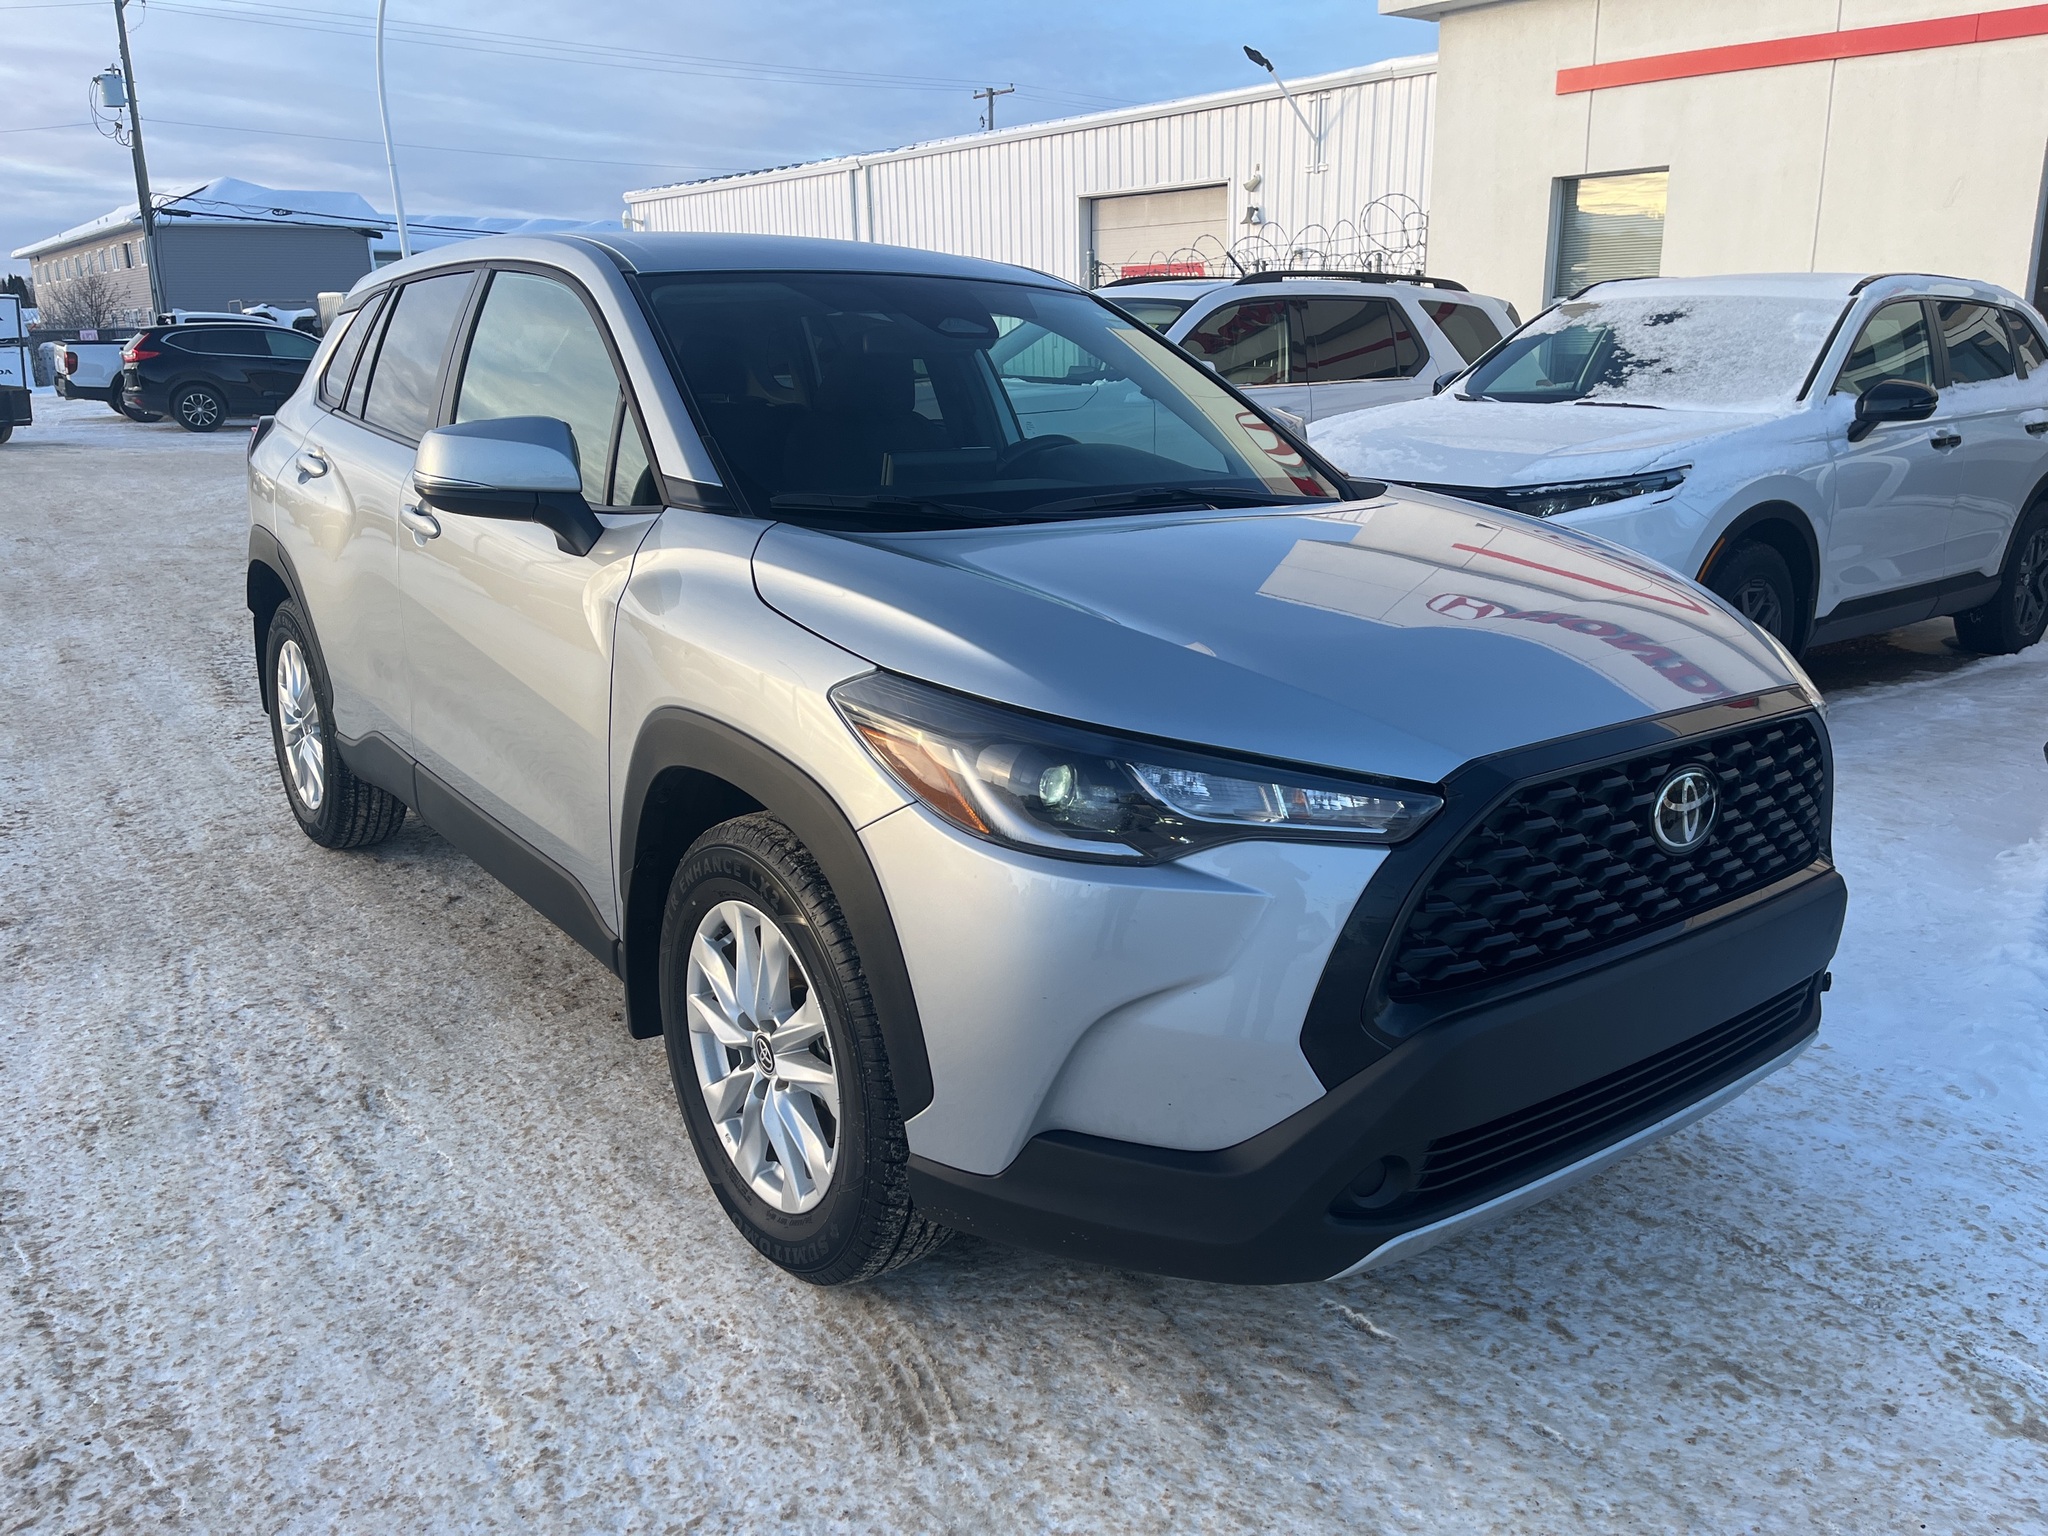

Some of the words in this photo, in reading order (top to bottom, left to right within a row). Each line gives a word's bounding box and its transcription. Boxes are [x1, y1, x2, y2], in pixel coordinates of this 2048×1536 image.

[679, 856, 742, 895] ENHANCE
[749, 868, 780, 910] LX2
[731, 1211, 829, 1265] SUMITOMO
